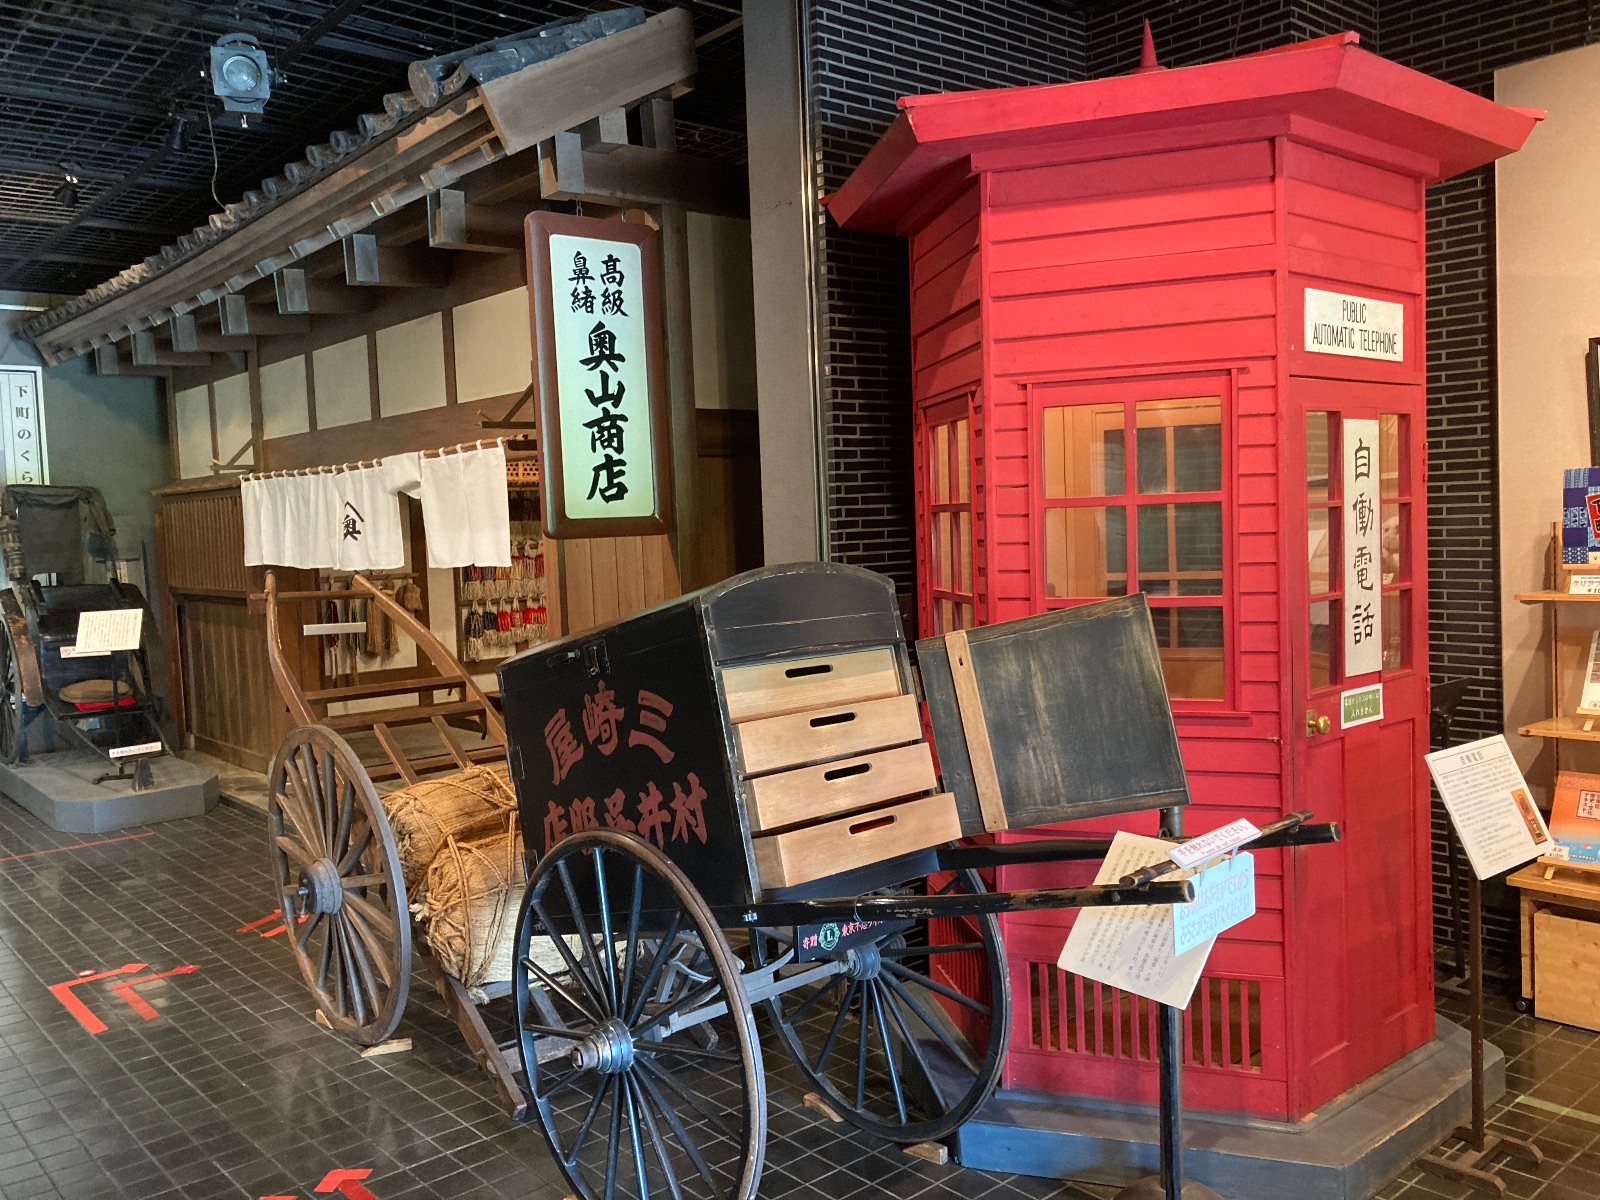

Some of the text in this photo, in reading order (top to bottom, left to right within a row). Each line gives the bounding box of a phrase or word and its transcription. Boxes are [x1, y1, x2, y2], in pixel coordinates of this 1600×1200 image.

[568, 250, 597, 315] 鼻緒
[1342, 299, 1367, 323] PUBLIC
[1312, 322, 1397, 355] AUTOMATIC TELEPHONE
[13, 385, 33, 483] 下町のくら
[578, 320, 629, 504] 奥山商店
